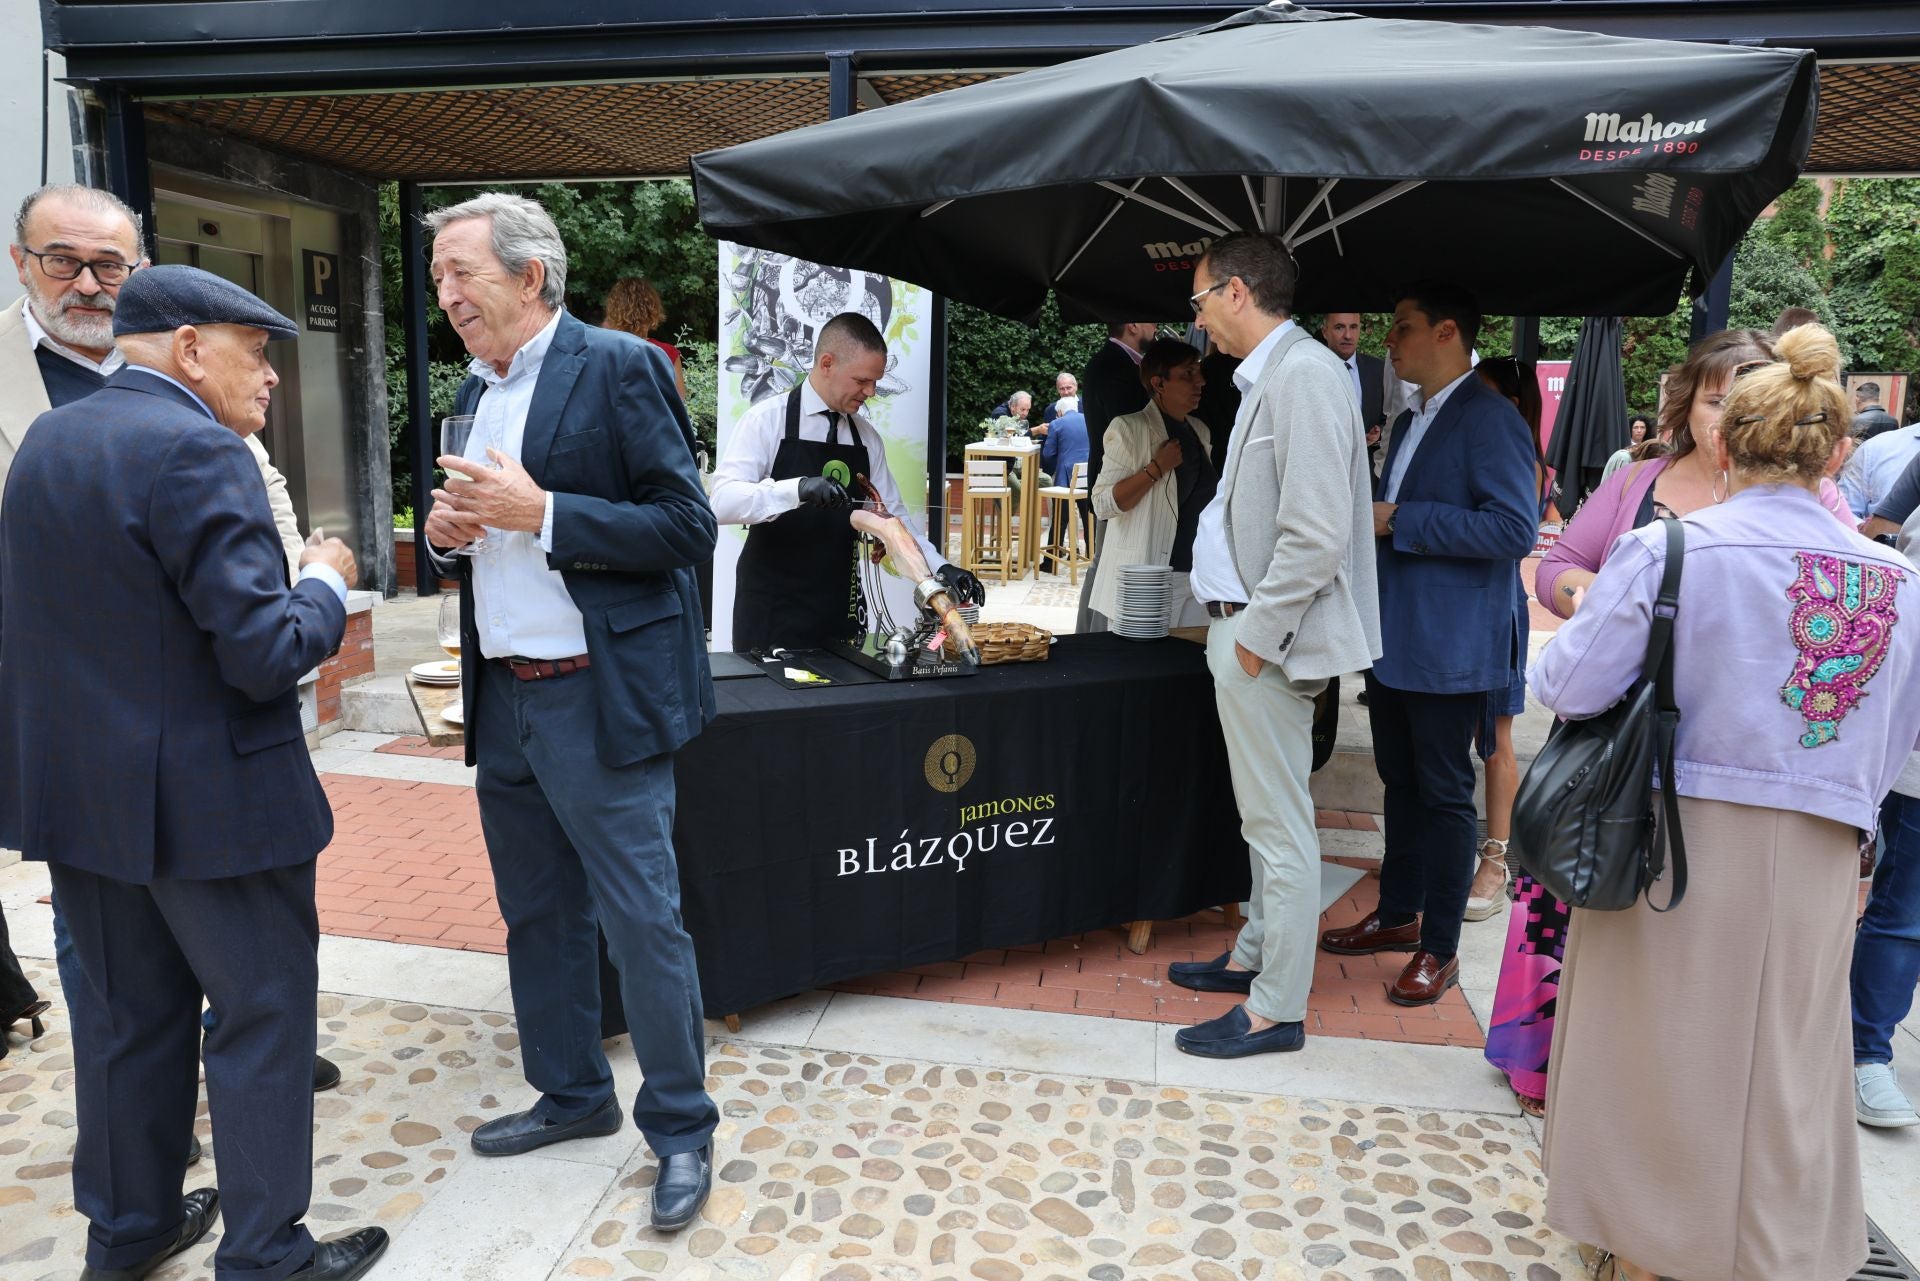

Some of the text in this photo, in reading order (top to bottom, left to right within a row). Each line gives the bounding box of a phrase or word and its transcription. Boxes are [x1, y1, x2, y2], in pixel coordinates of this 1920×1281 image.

[1584, 112, 1707, 143] Mahou
[1653, 141, 1698, 154] 1890
[1142, 237, 1211, 259] Ma
[1154, 260, 1191, 272] DES
[312, 255, 332, 295] P
[310, 304, 337, 315] ACCESO
